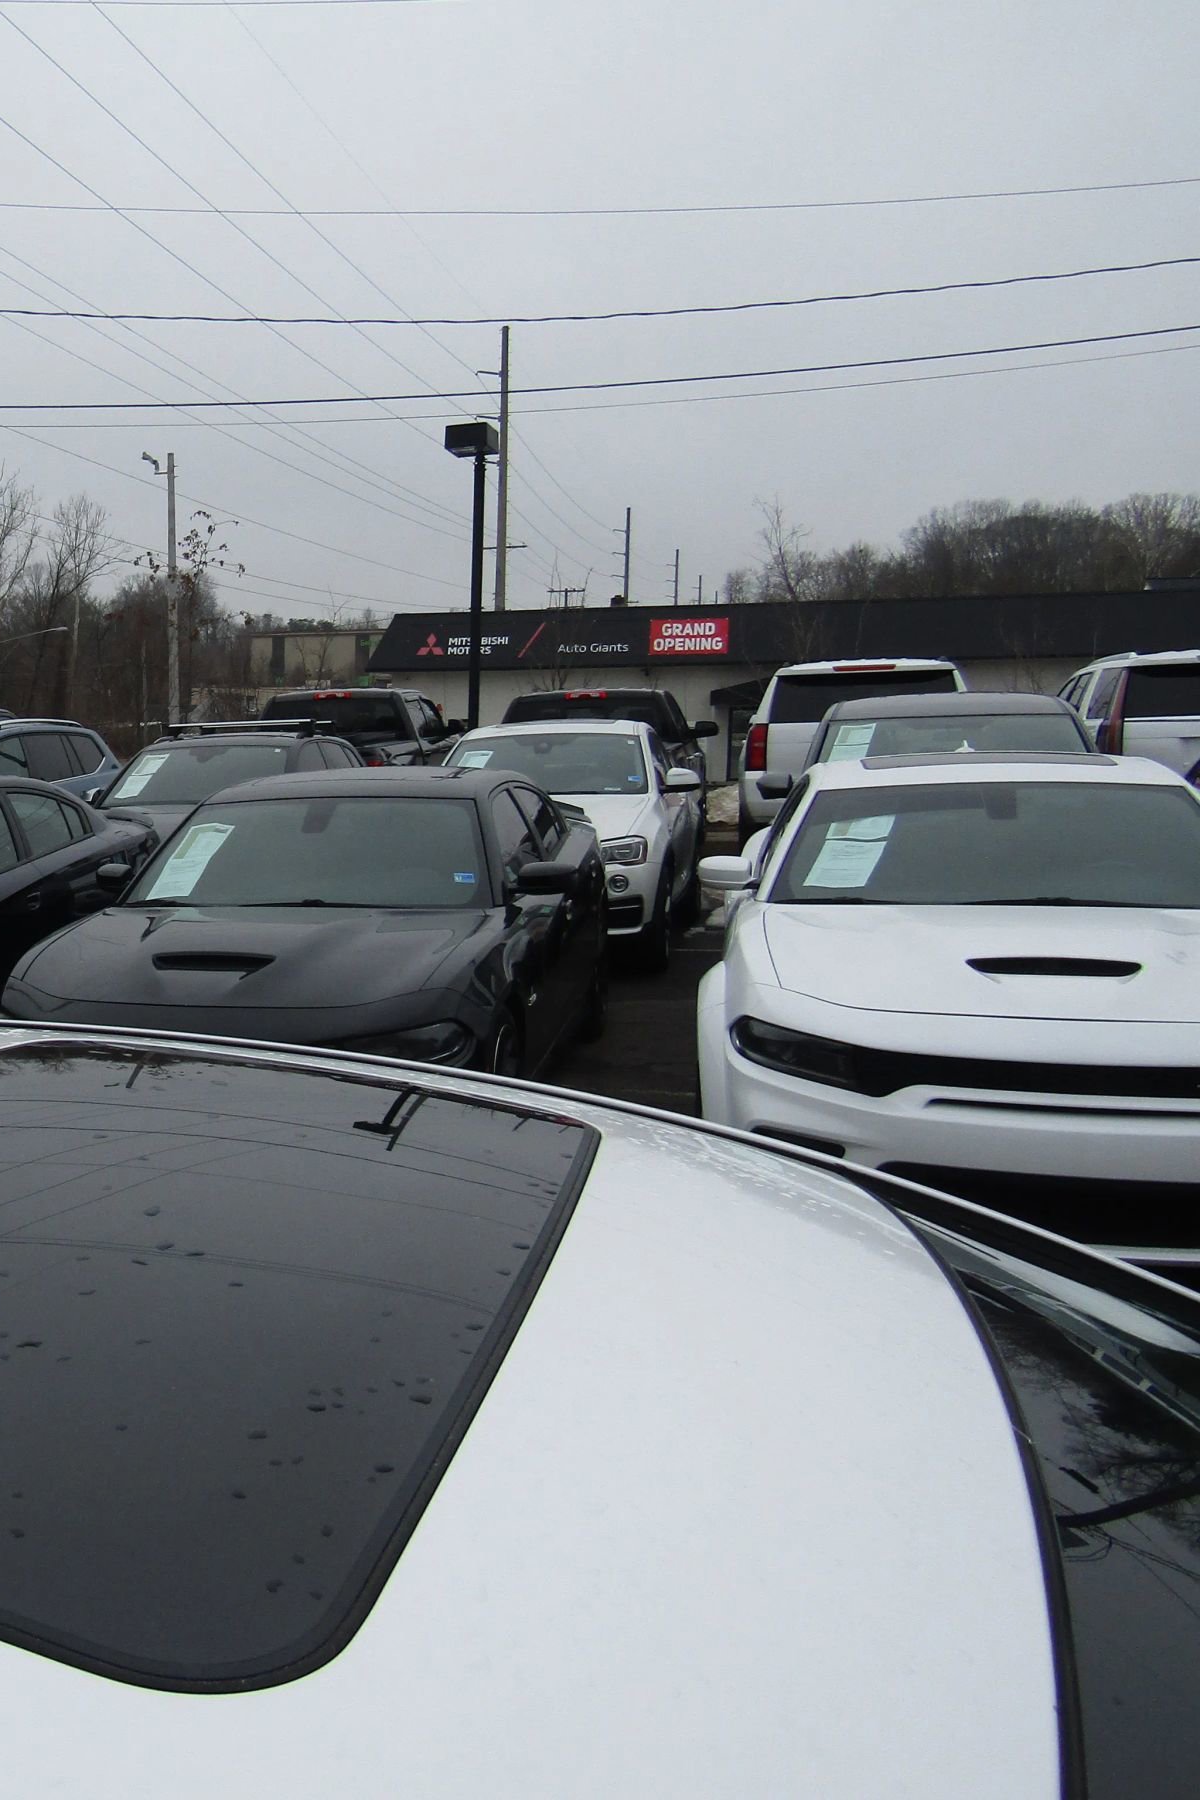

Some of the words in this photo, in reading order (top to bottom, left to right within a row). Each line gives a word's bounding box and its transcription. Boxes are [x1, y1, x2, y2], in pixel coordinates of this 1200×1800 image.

[661, 623, 716, 636] GRAND
[448, 636, 509, 646] MITBISHI
[653, 637, 723, 651] OPENING
[447, 646, 492, 655] MOTRS
[557, 643, 587, 653] Auto
[590, 642, 629, 652] Giants
